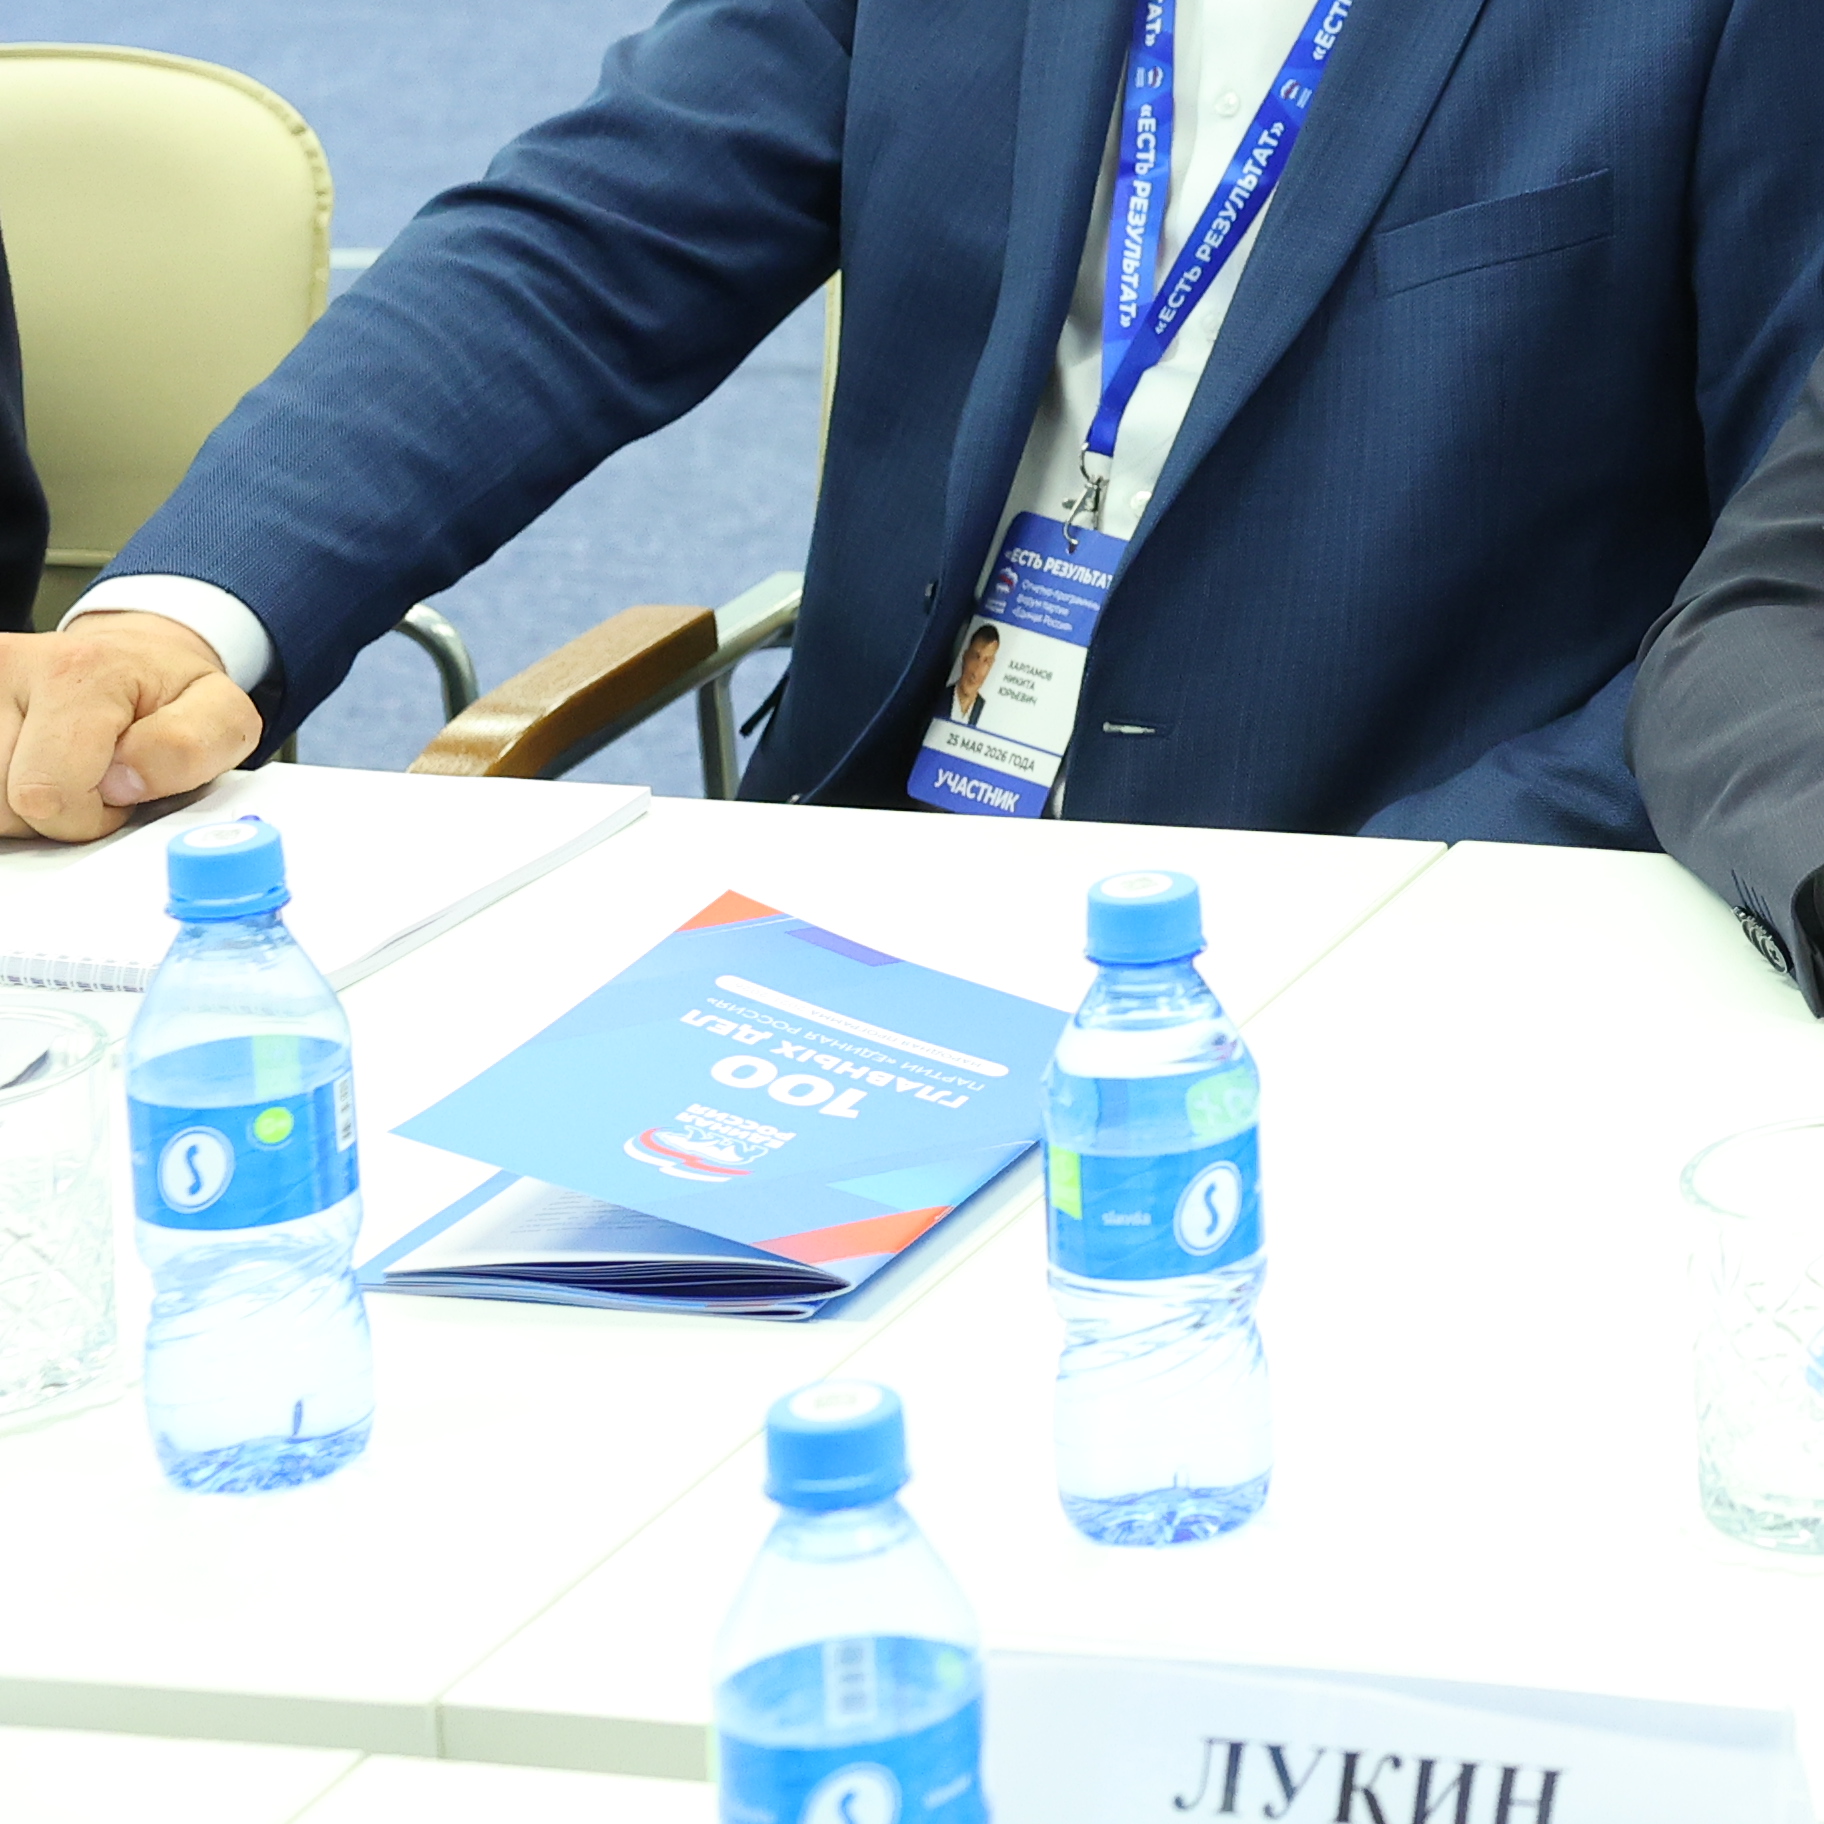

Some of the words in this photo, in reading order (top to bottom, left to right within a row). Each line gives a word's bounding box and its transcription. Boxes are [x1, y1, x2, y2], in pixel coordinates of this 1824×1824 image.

[1134, 104, 1158, 175] «ЕСТЬ
[1154, 266, 1202, 335] «ЕСТЬ
[1195, 121, 1285, 263] РЕЗУЛЬТАТ»
[1119, 179, 1152, 328] РЕЗУЛЬТАТ»
[960, 738, 982, 753] МАЯ
[1008, 753, 1036, 772] ГОДА
[934, 768, 1020, 813] УЧАСТНИК
[679, 1009, 773, 1045] ДЕЛ
[706, 997, 802, 1035] РОССИЯ»
[803, 1031, 897, 1064] «ЕДИНАЯ
[710, 1054, 868, 1119] 100
[769, 1040, 970, 1109] ГЛАВНЫХ
[900, 1061, 986, 1091] ПАРТИИ
[674, 1112, 785, 1149] ЕДИНАЯ
[686, 1103, 797, 1141] РОССИЯ
[1172, 1736, 1568, 1824] ЛУКИН
